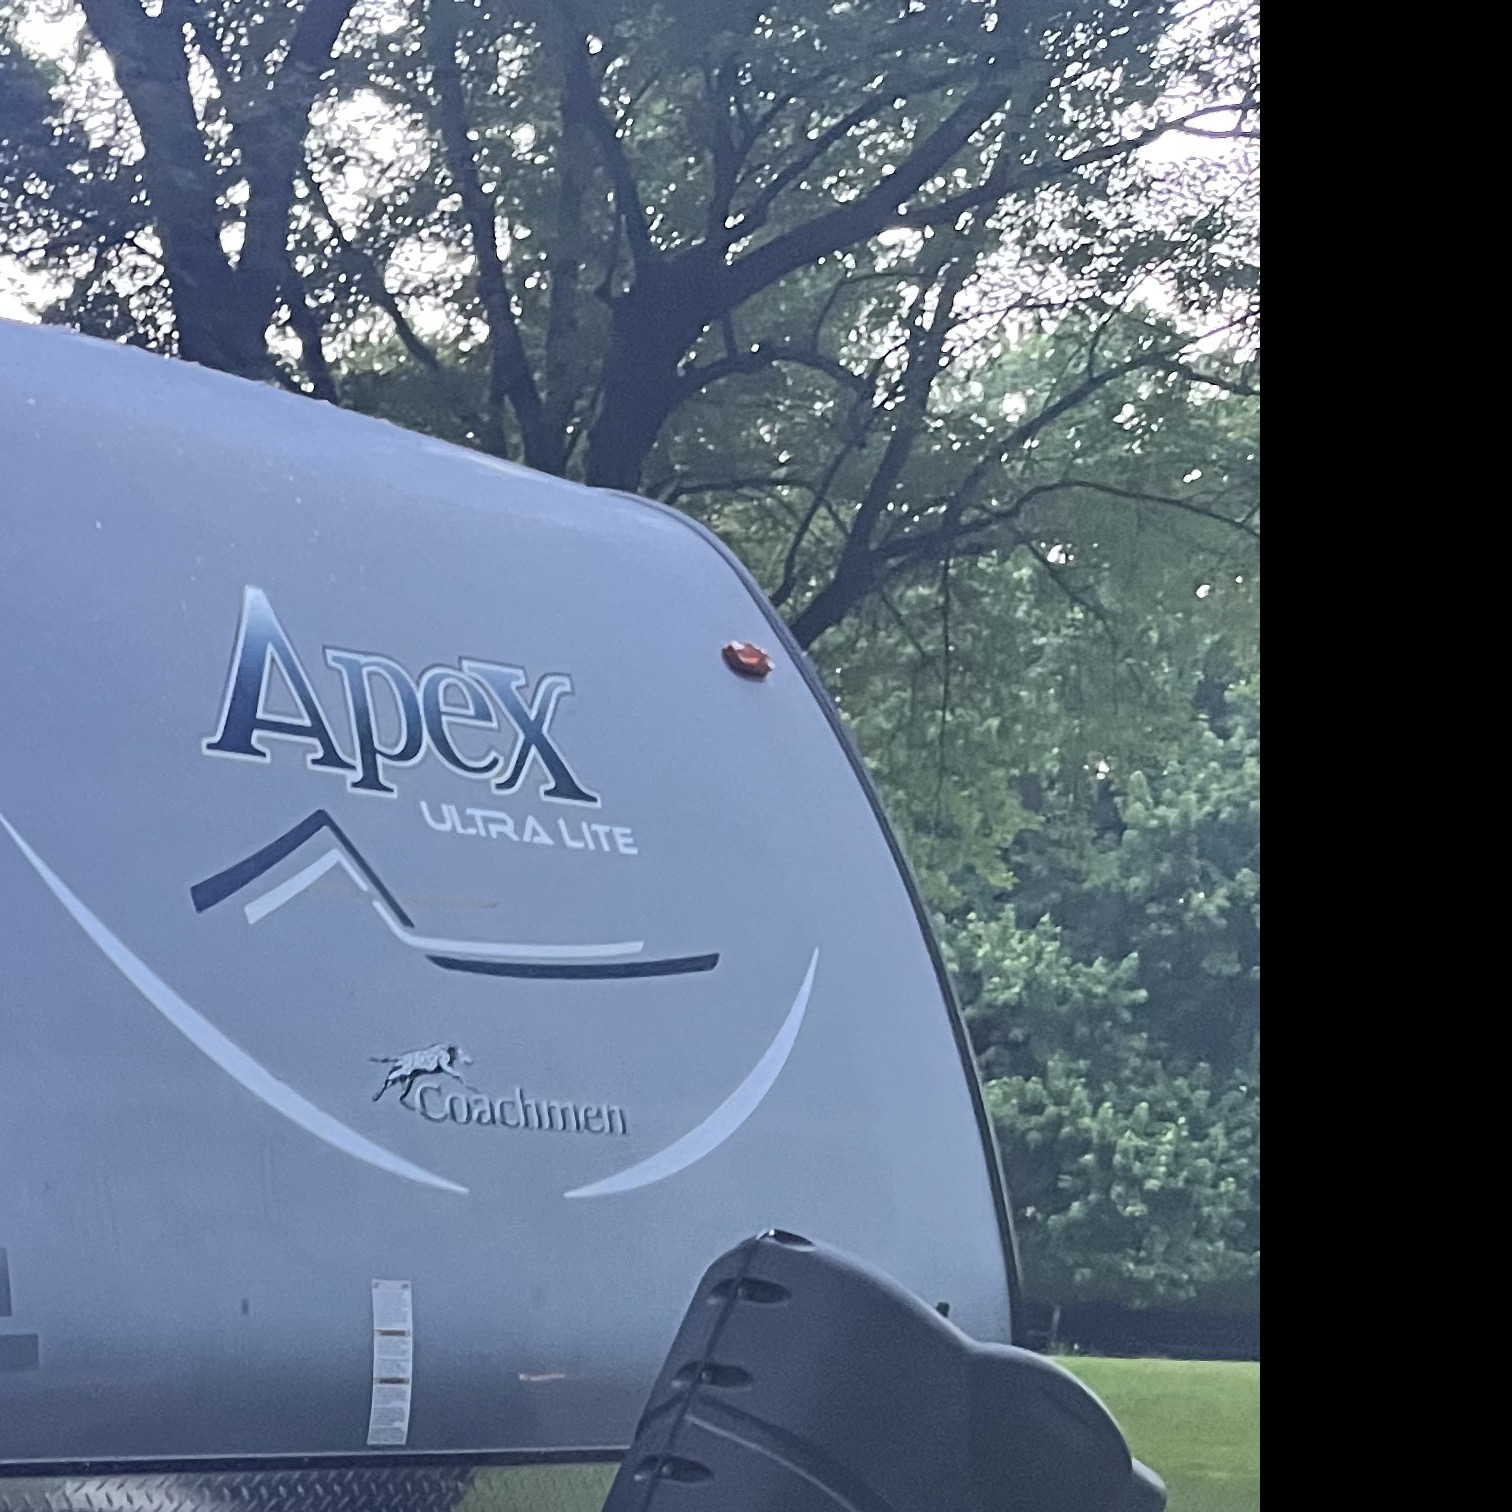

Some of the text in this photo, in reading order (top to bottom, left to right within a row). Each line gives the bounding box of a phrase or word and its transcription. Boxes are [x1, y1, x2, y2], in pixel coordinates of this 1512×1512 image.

[201, 584, 602, 808] Apex
[419, 800, 640, 855] ULTRA LITE
[415, 1083, 628, 1135] Coachmen
